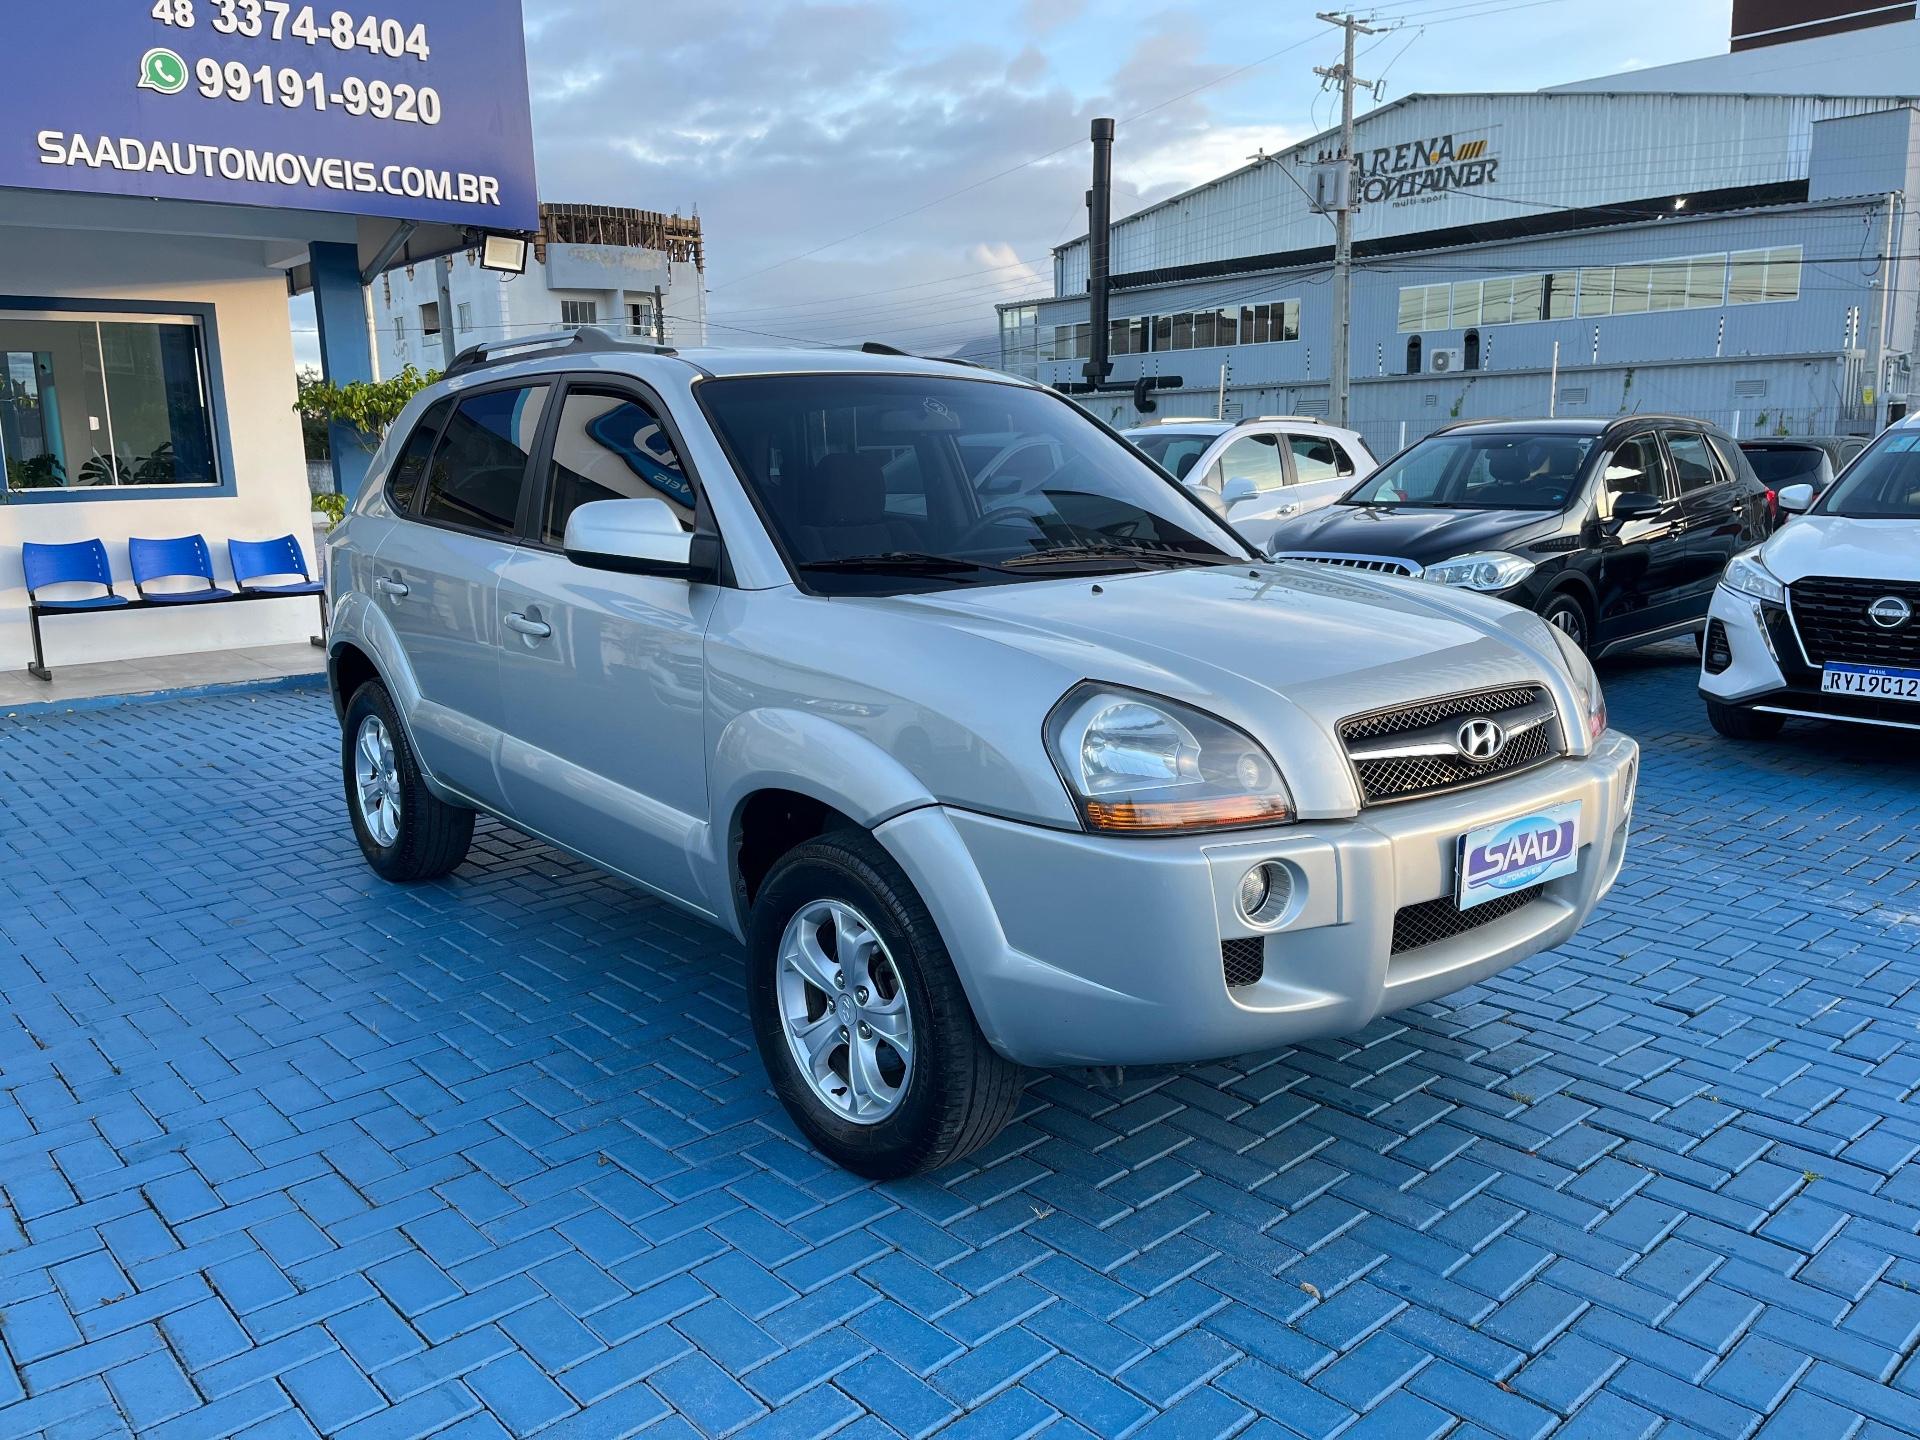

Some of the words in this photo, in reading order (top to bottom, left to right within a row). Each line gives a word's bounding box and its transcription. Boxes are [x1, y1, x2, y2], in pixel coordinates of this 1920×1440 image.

[152, 0, 195, 28] 48
[211, 0, 429, 61] 3374-8404
[196, 57, 441, 125] 99191-9920
[37, 130, 501, 206] SAADAUTOMOVEIS.COM.BR
[1354, 135, 1455, 178] ARENA
[1359, 159, 1498, 202] ONTAINER
[1392, 197, 1417, 208] multi
[1420, 194, 1447, 204] sport
[1868, 608, 1910, 617] NISSAN
[1830, 672, 1919, 697] RYI9C12
[1484, 825, 1562, 873] SAAD
